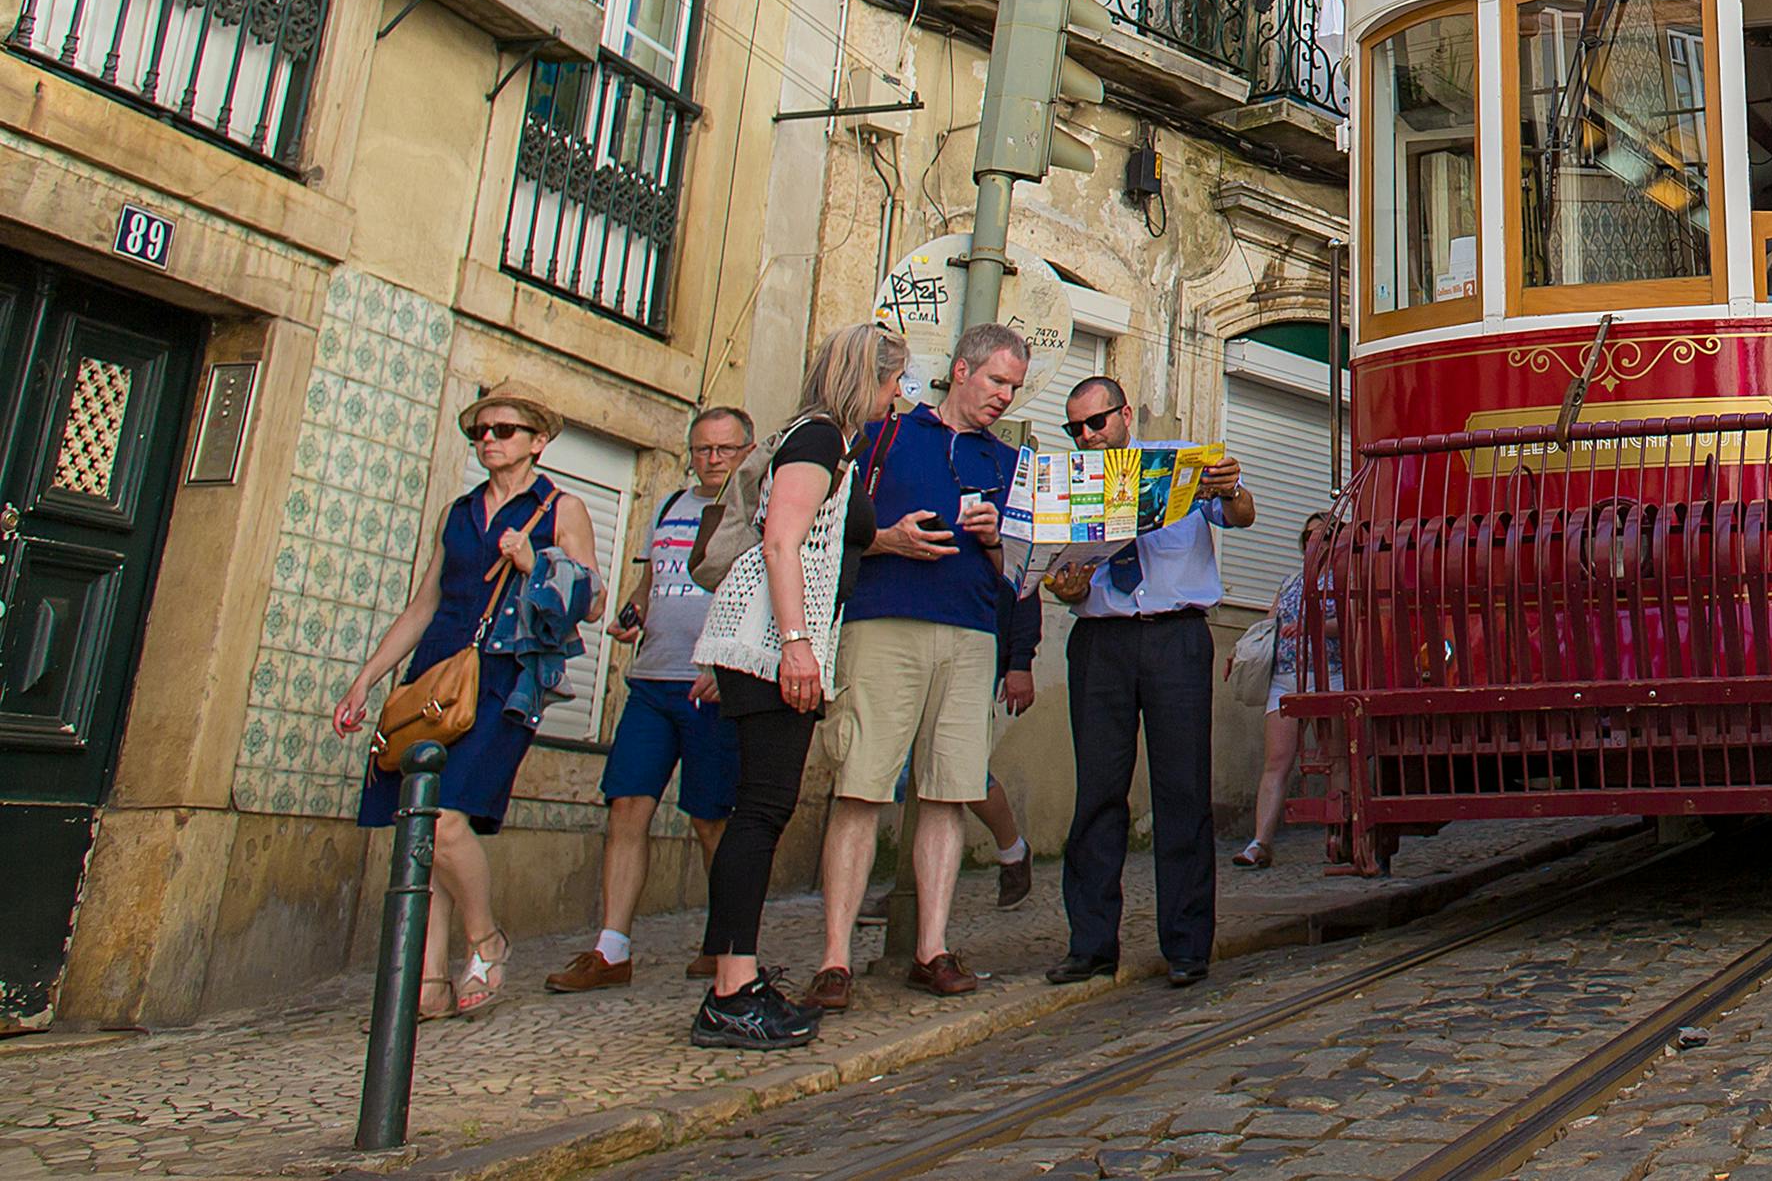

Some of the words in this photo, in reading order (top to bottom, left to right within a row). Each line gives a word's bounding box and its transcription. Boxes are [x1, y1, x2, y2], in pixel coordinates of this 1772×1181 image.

[126, 213, 165, 260] 89
[1035, 326, 1059, 338] 7470
[1025, 335, 1065, 349] CLXXX
